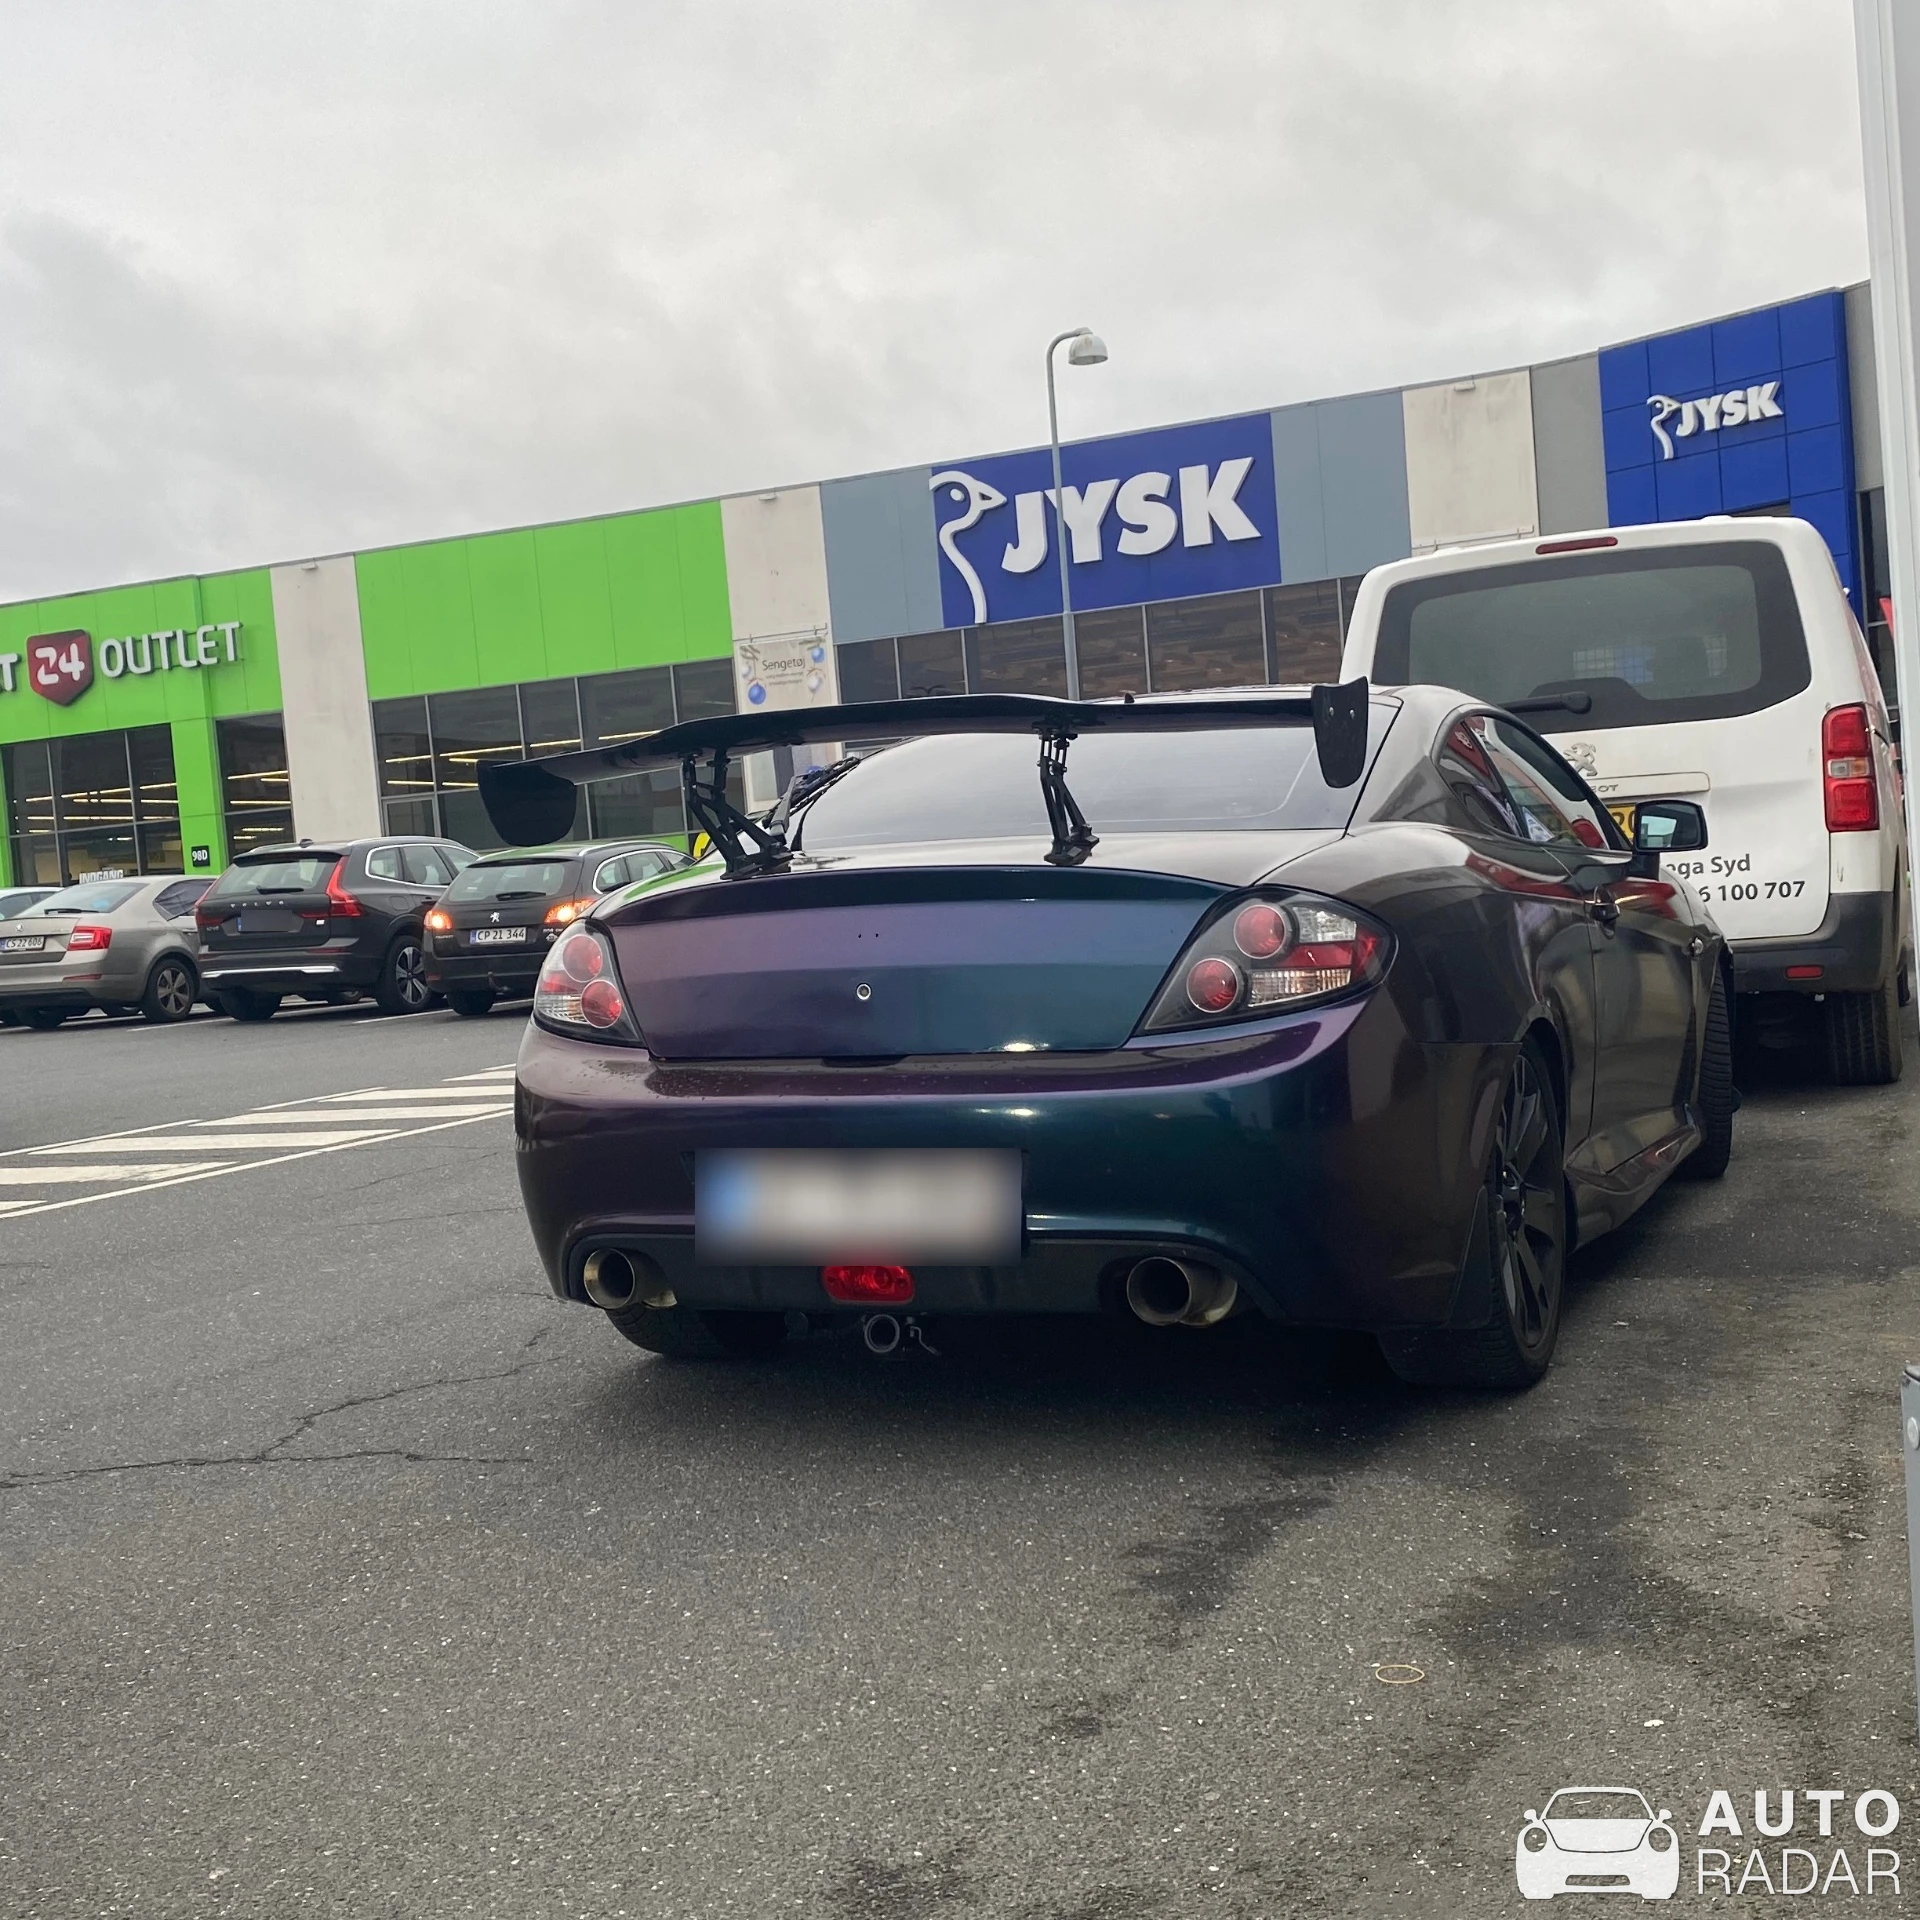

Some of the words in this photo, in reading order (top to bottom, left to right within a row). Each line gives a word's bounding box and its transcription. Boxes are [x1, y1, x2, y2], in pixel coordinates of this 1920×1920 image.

[1675, 380, 1784, 437] JYSK
[1001, 457, 1261, 573] JYSK
[0, 652, 20, 691] T
[35, 643, 85, 685] 24
[100, 621, 244, 678] OUTLET
[762, 658, 806, 671] Sengetøj
[192, 849, 208, 861] 98D
[1711, 854, 1751, 877] Syd
[1698, 886, 1711, 903] 6
[1717, 883, 1758, 901] 100
[1764, 881, 1805, 899] 707
[477, 930, 491, 941] CP
[492, 929, 503, 940] 21
[507, 928, 525, 939] 344
